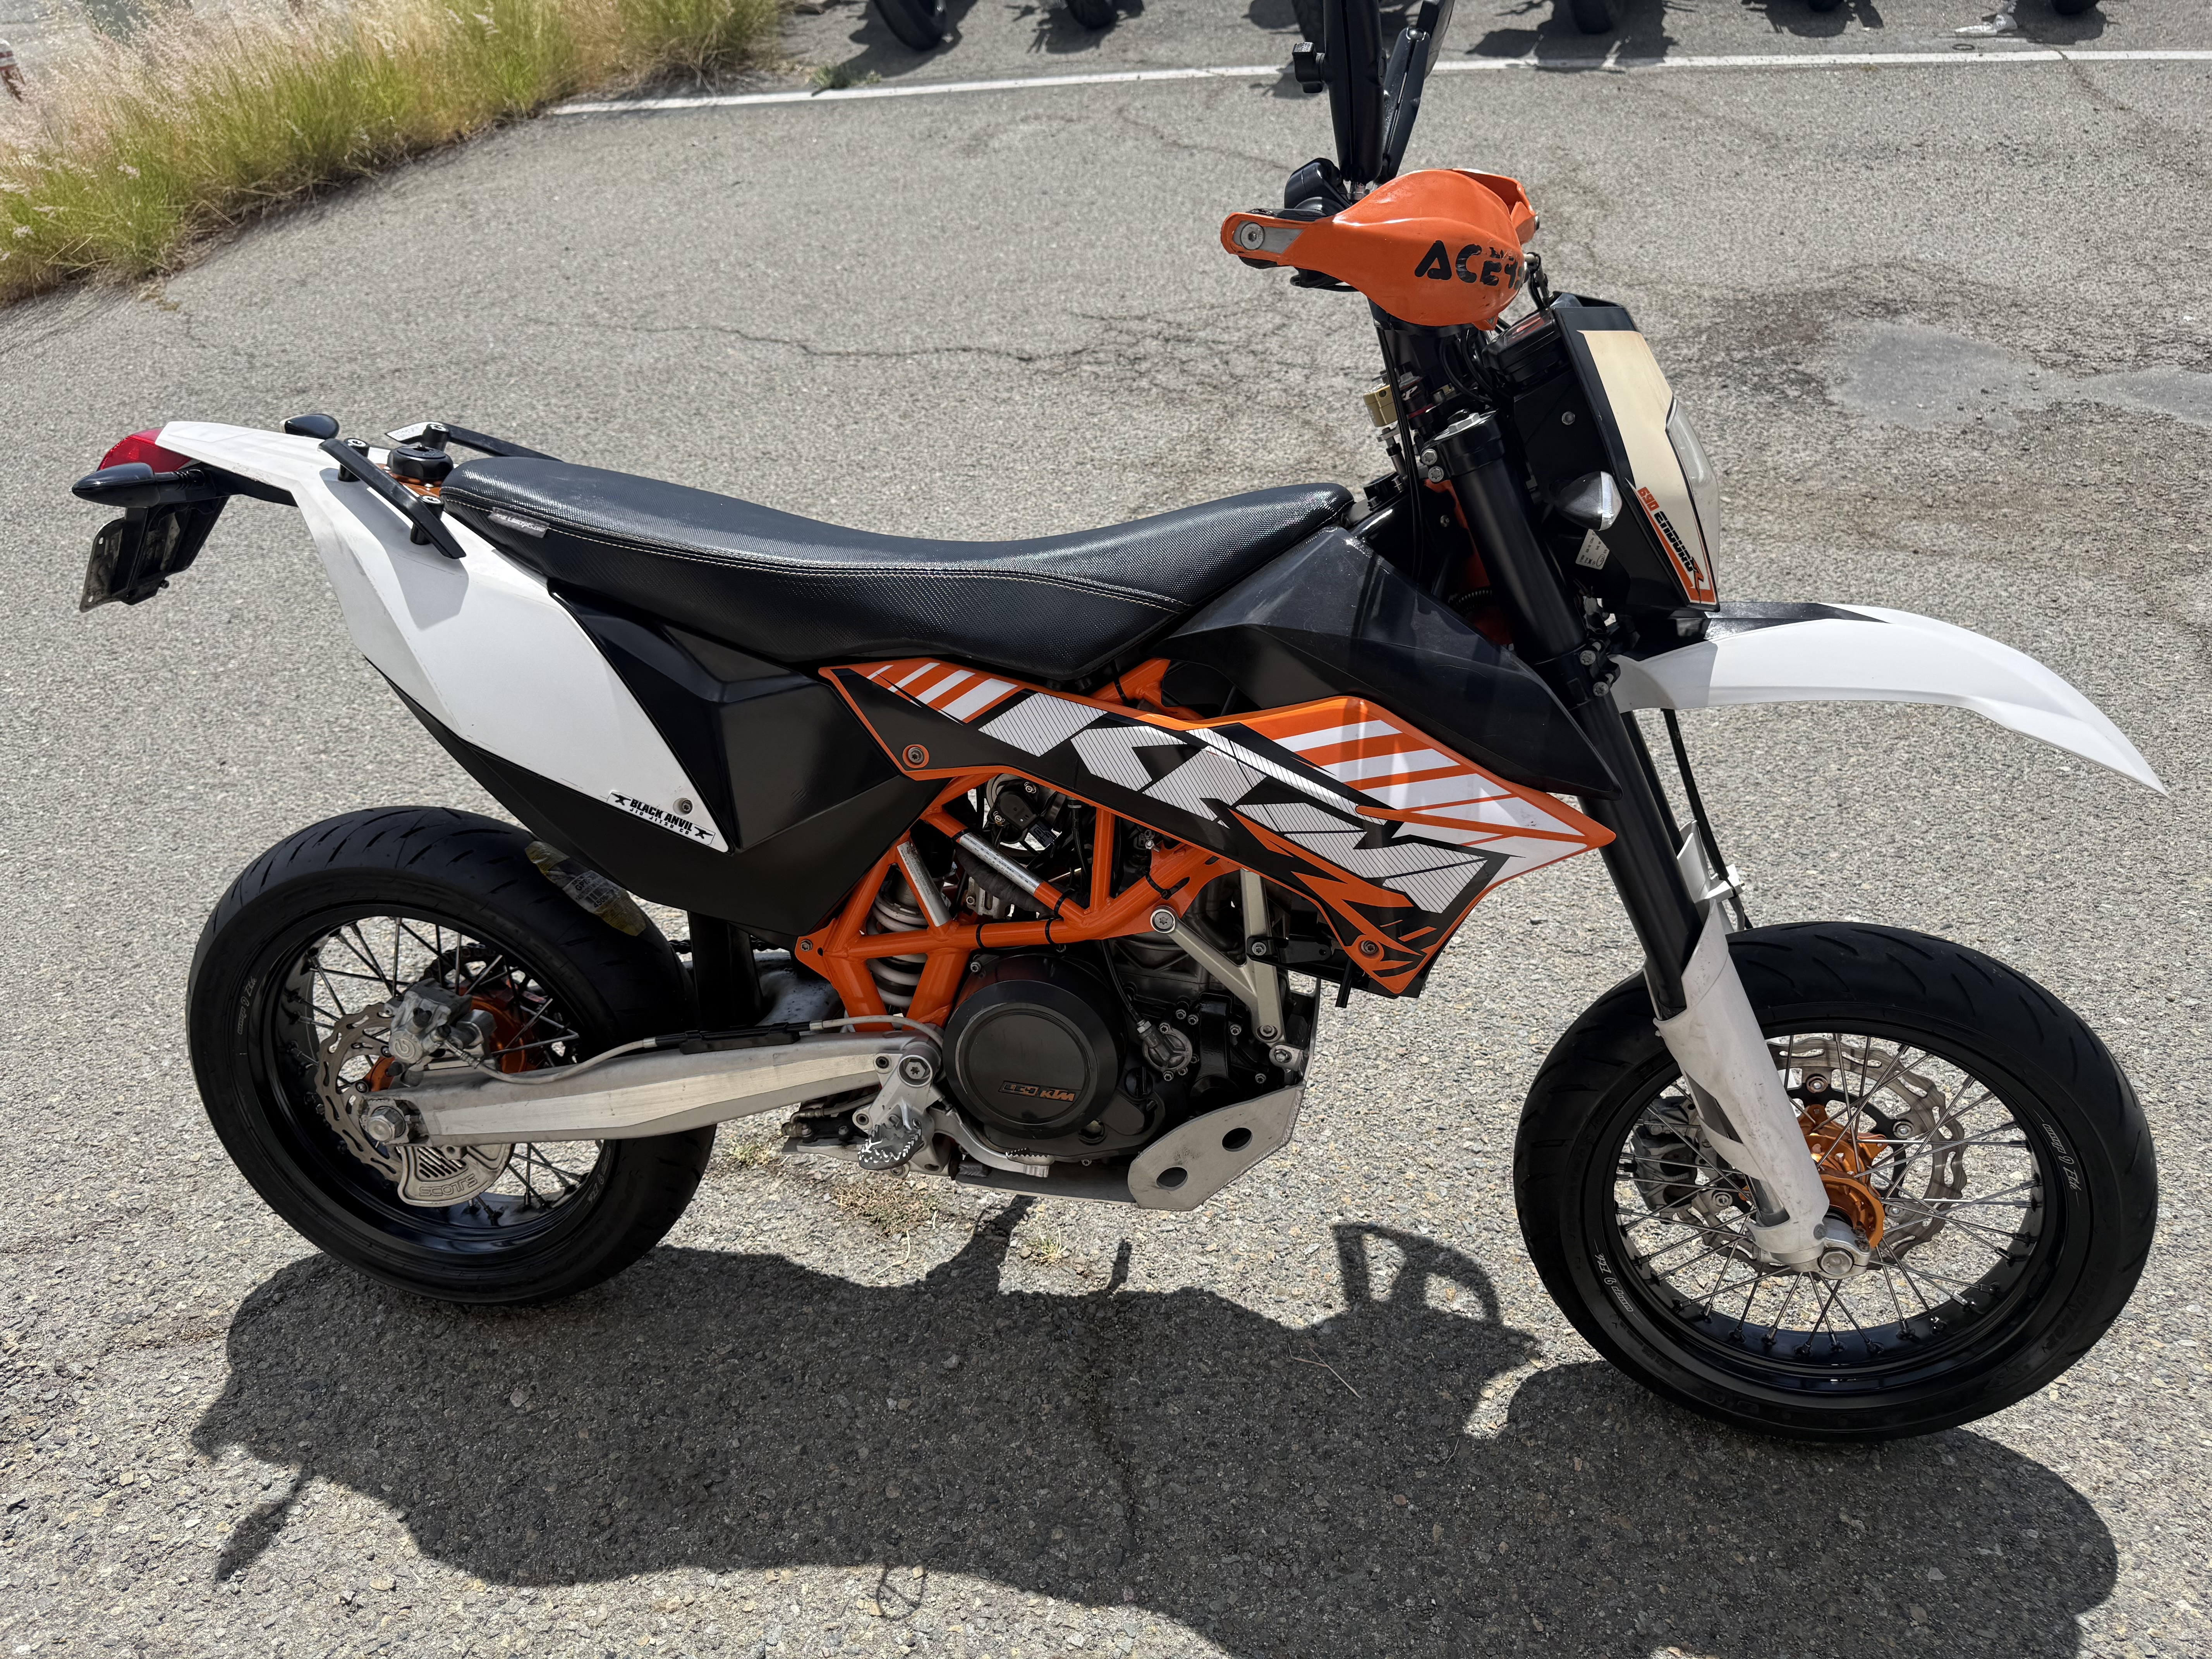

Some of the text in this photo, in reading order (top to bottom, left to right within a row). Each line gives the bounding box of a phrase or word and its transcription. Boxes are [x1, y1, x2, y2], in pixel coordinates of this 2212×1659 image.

[1637, 487, 1659, 511] 690
[1654, 511, 1694, 572] ENDURO
[630, 799, 693, 831] BLACK ANVIL
[649, 816, 674, 828] JITSU
[240, 996, 249, 1006] 9
[1040, 1088, 1075, 1101] KTM
[2058, 1156, 2074, 1164] 9
[419, 1173, 478, 1196] SCOTTS
[597, 1173, 604, 1184] 9
[2063, 1166, 2081, 1190] Elite
[1595, 1253, 1612, 1273] Elite
